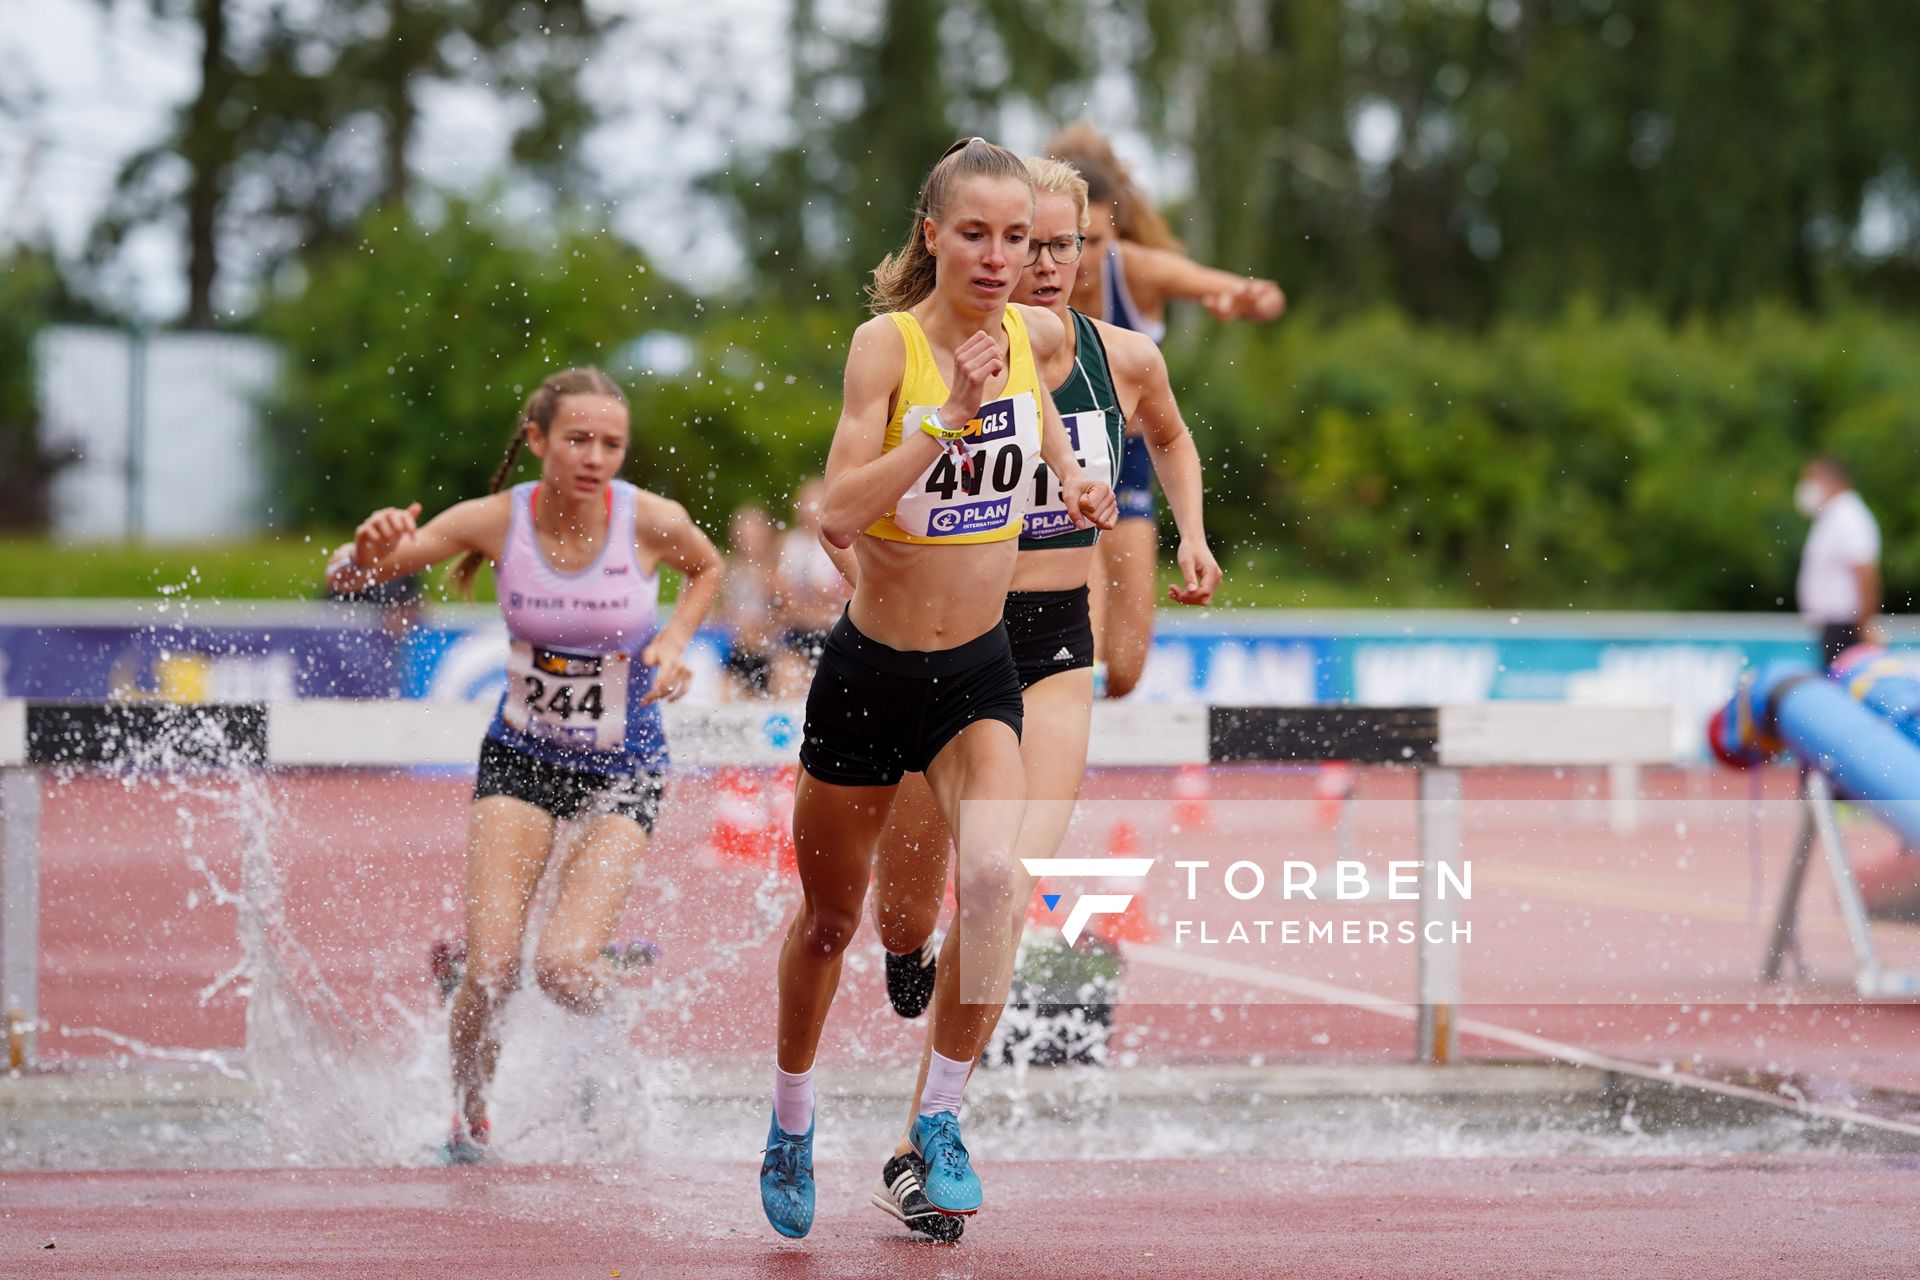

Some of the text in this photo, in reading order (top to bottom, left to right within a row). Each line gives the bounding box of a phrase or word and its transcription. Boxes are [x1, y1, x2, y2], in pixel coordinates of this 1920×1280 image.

[982, 411, 1008, 434] GLS
[925, 444, 1023, 500] 410
[962, 519, 1005, 529] INTERNATIONAL
[963, 503, 1008, 522] PLAN
[525, 677, 604, 720] 244
